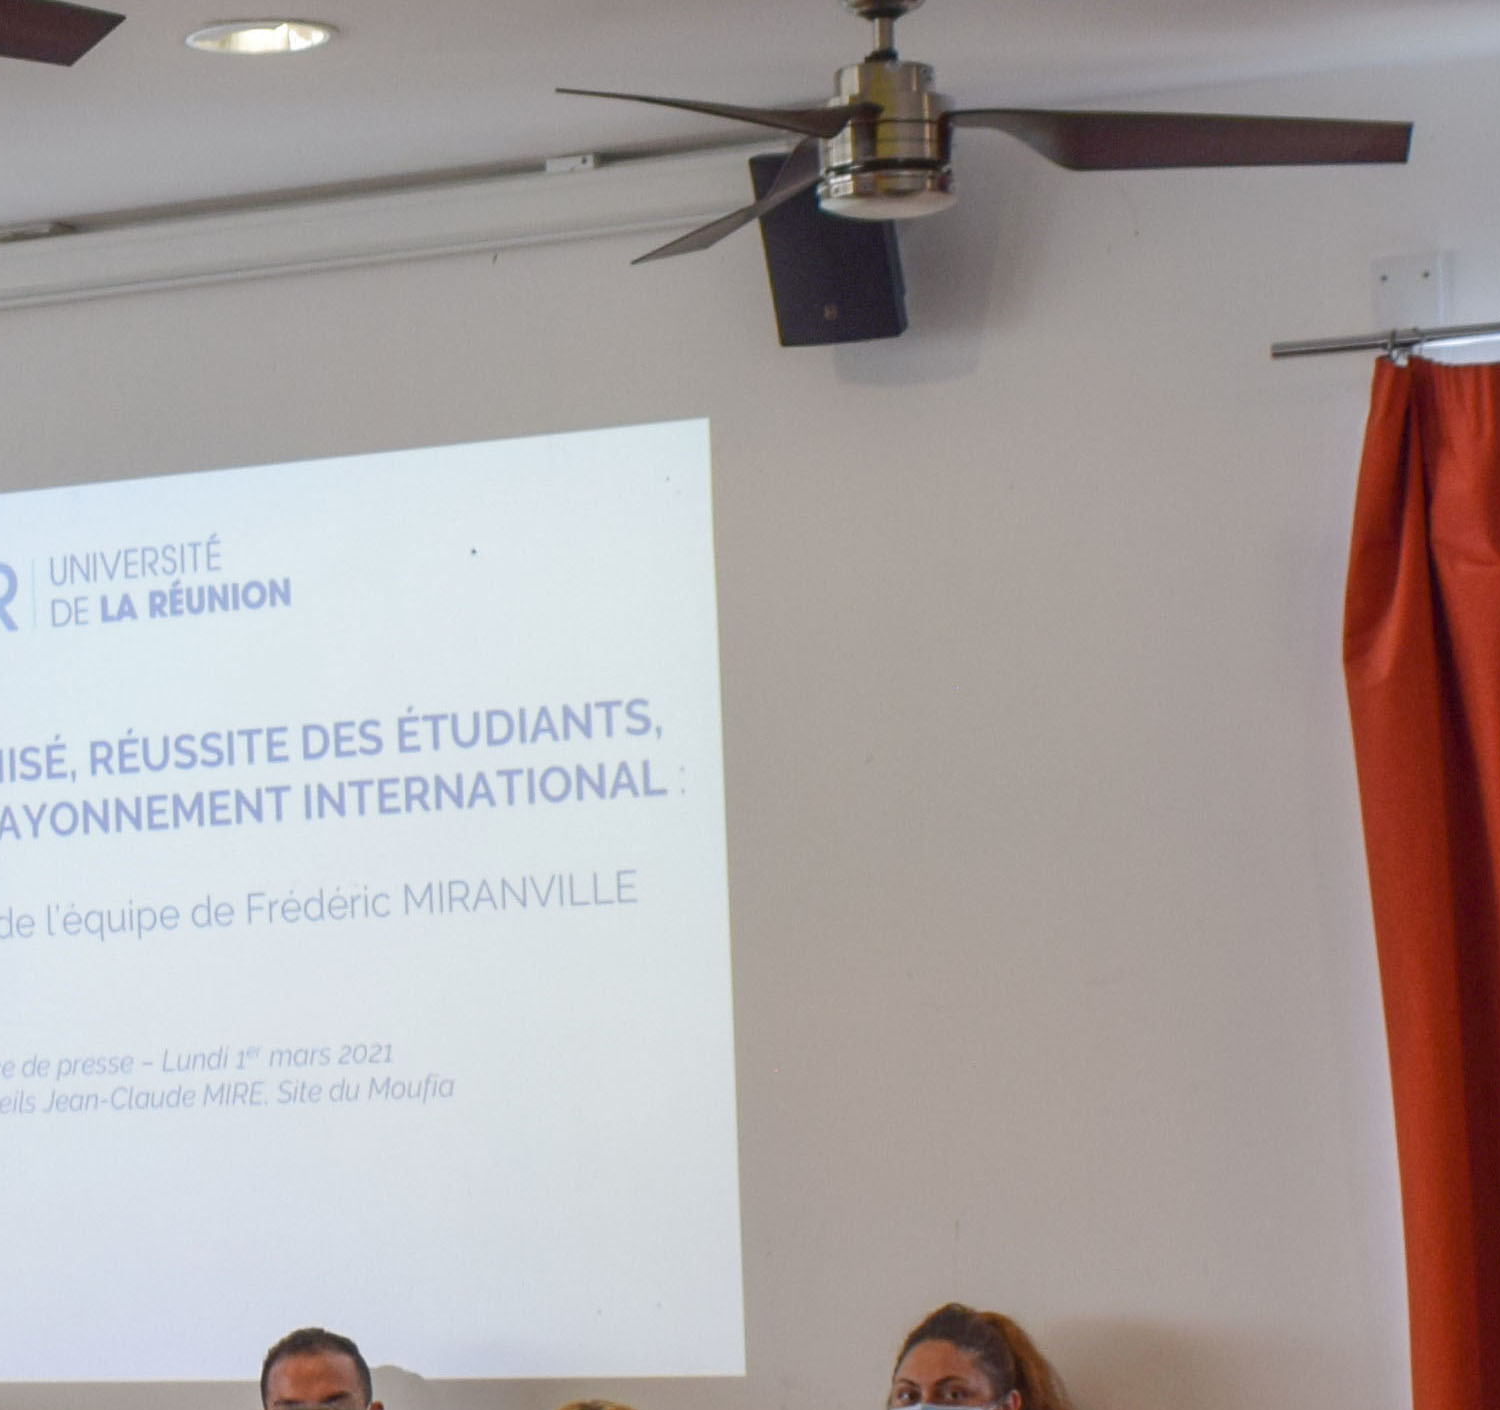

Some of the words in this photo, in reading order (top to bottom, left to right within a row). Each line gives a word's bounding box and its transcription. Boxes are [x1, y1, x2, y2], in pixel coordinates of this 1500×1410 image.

[49, 532, 222, 586] UNIVERSITÉ
[50, 596, 89, 629] DE
[99, 592, 139, 624] LA
[147, 576, 292, 620] RÉUNION
[89, 725, 290, 778] RÉUSSITE
[300, 718, 384, 762] DES
[396, 697, 663, 755] ÉTUDIANTS,
[303, 759, 669, 822] INTERNATIONAL
[190, 894, 235, 929] de
[246, 885, 391, 925] Frédéric
[403, 869, 638, 916] MIRANVILLE
[21, 1055, 51, 1078] de
[55, 1055, 134, 1081] presse
[161, 1046, 228, 1073] Lundi
[269, 1047, 331, 1068] mars
[337, 1043, 392, 1066] 2021
[42, 1085, 196, 1113] Jean-Claude
[277, 1079, 323, 1105] Site
[329, 1078, 360, 1103] du
[368, 1073, 455, 1104] Moufia
